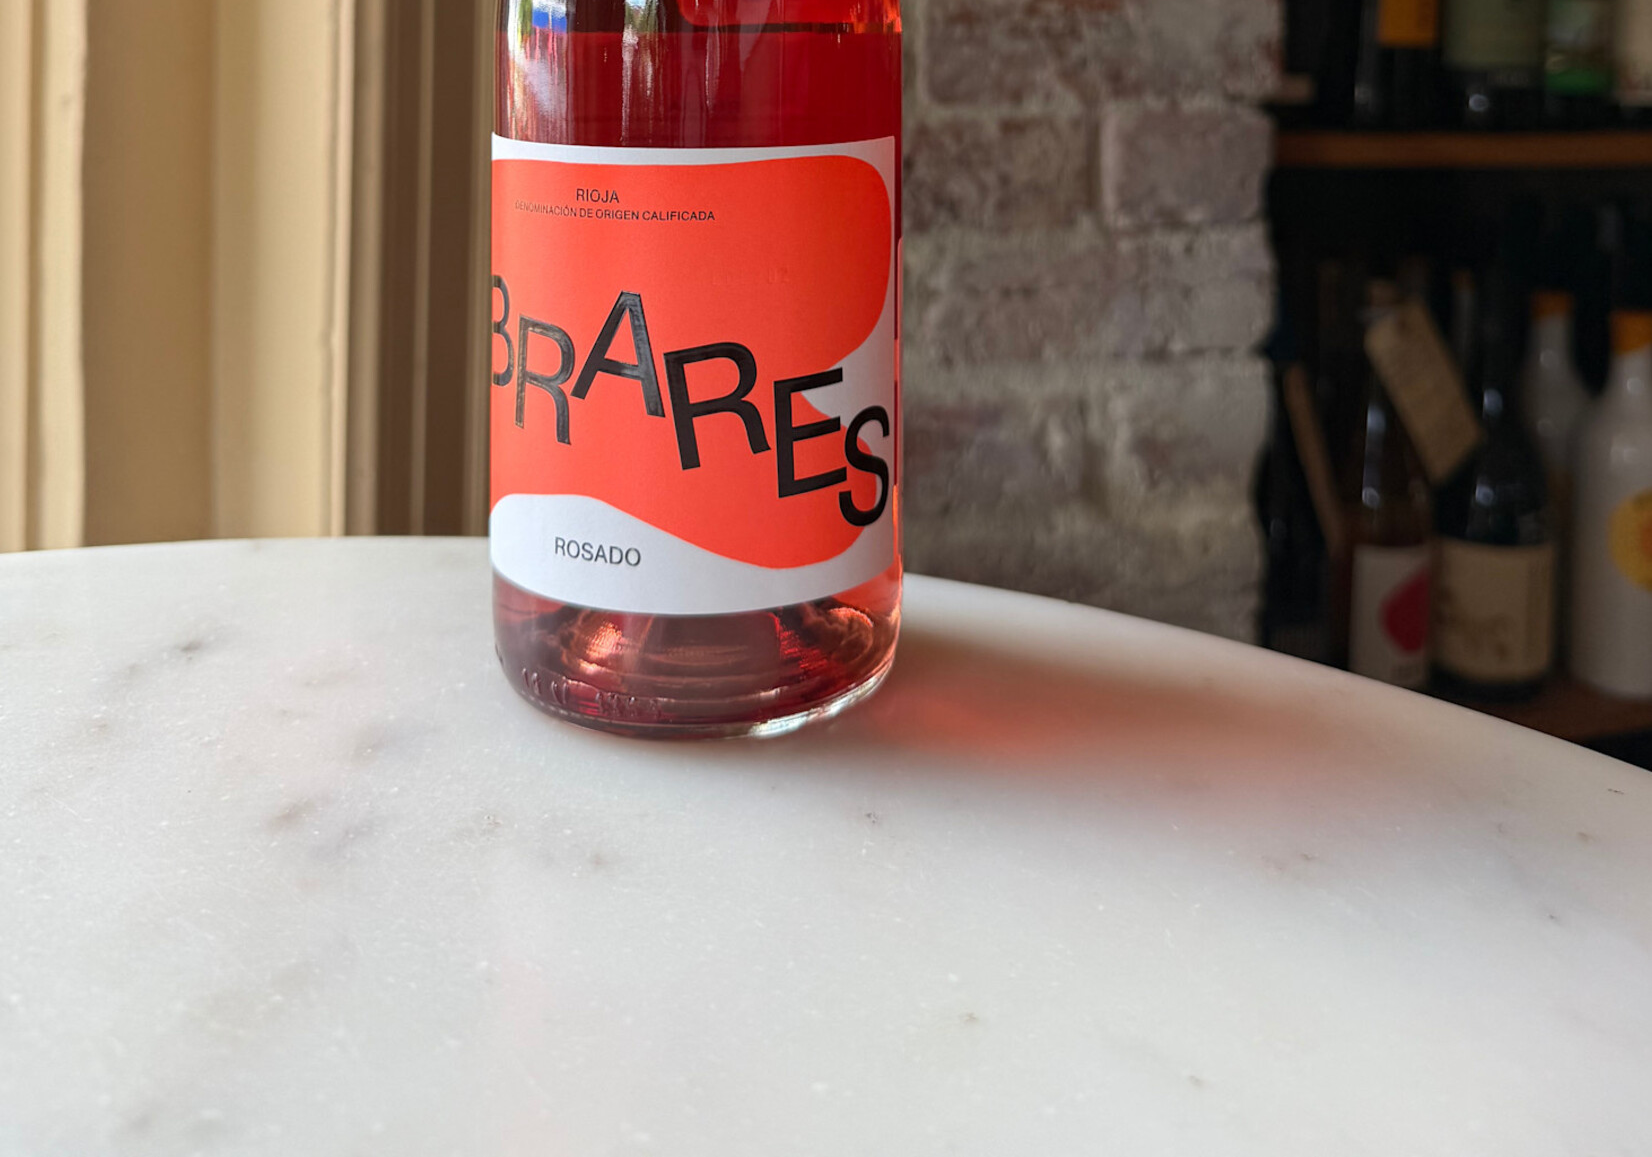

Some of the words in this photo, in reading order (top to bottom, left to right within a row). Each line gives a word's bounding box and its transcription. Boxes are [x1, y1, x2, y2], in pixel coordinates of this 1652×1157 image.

[576, 188, 620, 204] RIOJA
[515, 200, 577, 217] DENOMINACIÓN
[579, 208, 594, 218] DE
[595, 209, 639, 220] ORIGEN
[642, 211, 715, 221] CALIFICADA
[555, 537, 641, 567] ROSADO
